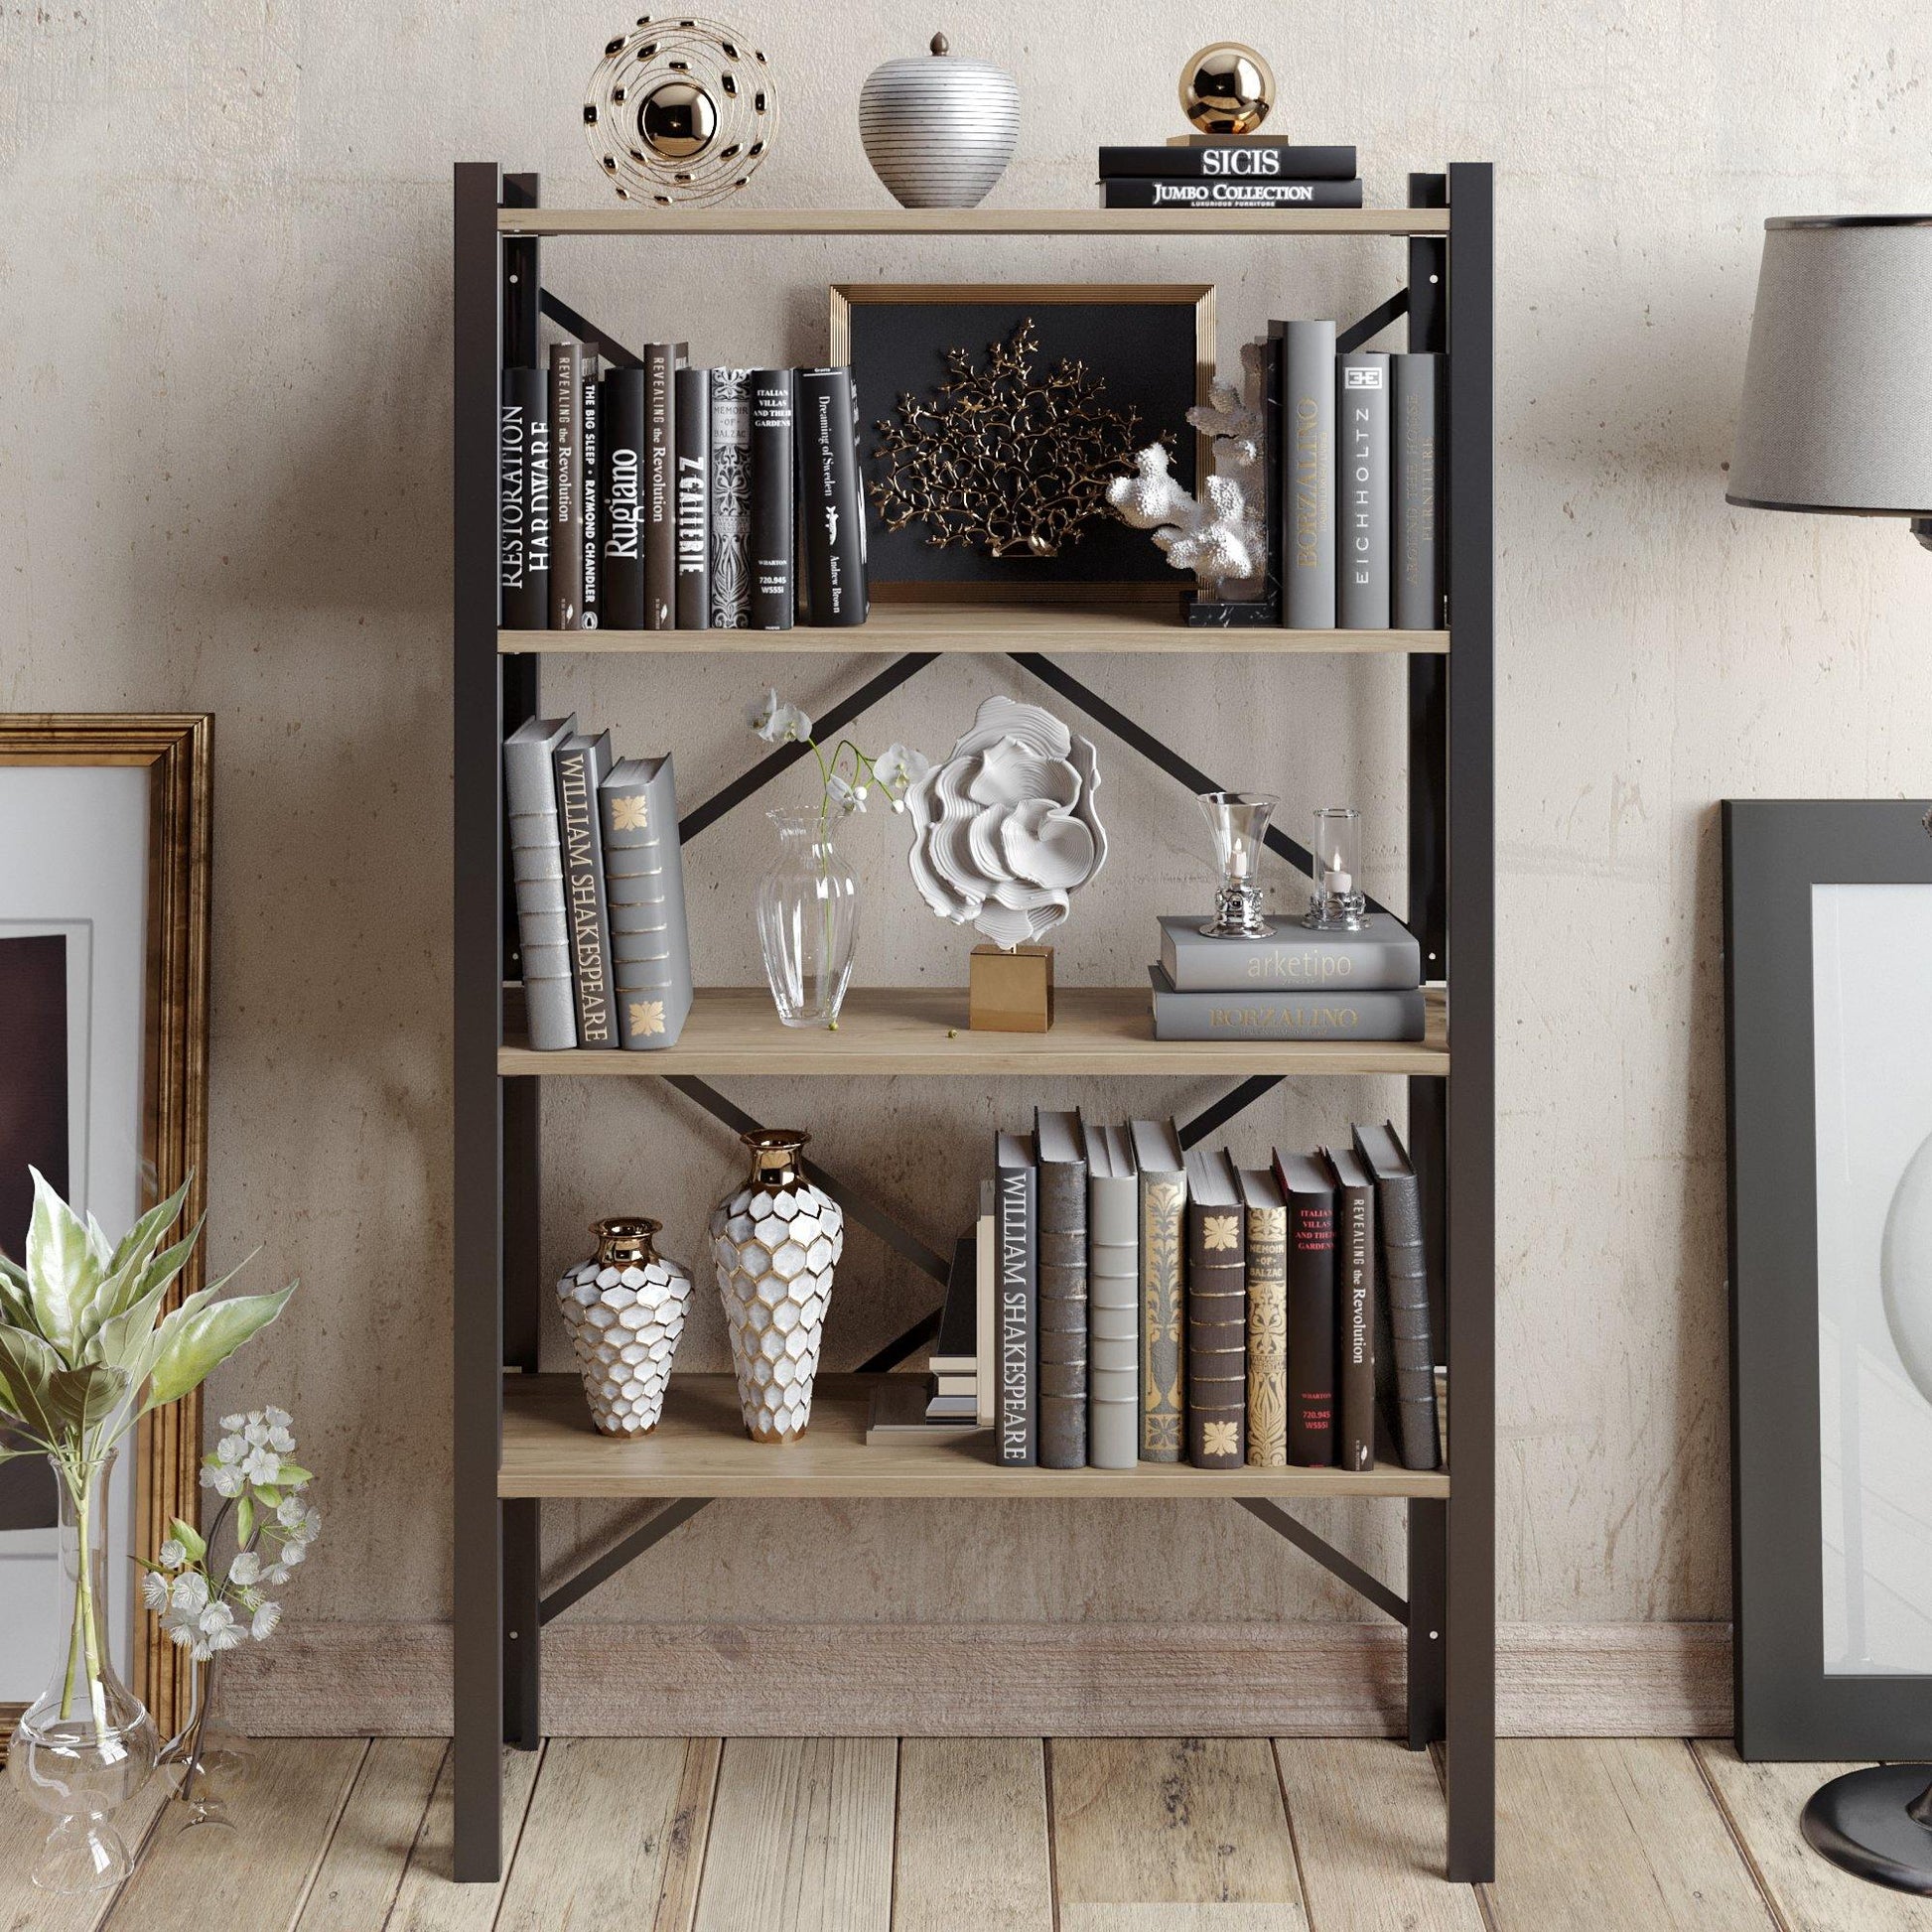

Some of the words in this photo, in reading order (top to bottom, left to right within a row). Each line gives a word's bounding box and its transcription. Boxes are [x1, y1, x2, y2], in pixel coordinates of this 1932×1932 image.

[1202, 149, 1280, 175] SICIS
[1153, 183, 1208, 204] JUMBO
[1212, 183, 1312, 201] COLLECTION
[558, 356, 570, 424] REVEALING
[585, 385, 596, 405] THE
[653, 356, 664, 424] REVEALING
[757, 388, 788, 397] ITALIAN
[585, 408, 596, 430] BIG
[714, 406, 748, 415] MEMOIR
[755, 419, 790, 428] GARDENS
[818, 396, 832, 445] Dreaming
[558, 427, 567, 444] the
[585, 433, 596, 467] SLEEP
[653, 427, 662, 444] the
[822, 447, 833, 458] of
[679, 456, 704, 472] Z
[823, 459, 834, 496] Sweden
[501, 405, 523, 589] RESTORATION
[528, 421, 549, 573] HARDWARE
[558, 447, 572, 523] Revolution
[653, 447, 666, 523] Revolution
[1296, 398, 1318, 570] BORZALINO
[1356, 408, 1369, 584] EICHHOLTZ
[585, 480, 596, 539] RAYMOND
[605, 448, 644, 560] Rugiano
[585, 542, 596, 603] CHANDLER
[830, 555, 841, 586] Andrew
[832, 588, 842, 615] Brown
[559, 753, 593, 868] WILLIAM
[571, 873, 608, 1041] SHAKESPEARE
[1247, 949, 1352, 983] arketipo
[1209, 1005, 1359, 1029] BORZALINO
[1003, 1173, 1027, 1285] WILLIAM
[1353, 1198, 1365, 1265] REVEALING
[1249, 1244, 1285, 1253] MEMOIR
[1249, 1268, 1283, 1277] BALZAC
[1353, 1270, 1362, 1285] the
[1353, 1289, 1366, 1364] Revolution
[1003, 1292, 1027, 1459] SHAKESPEARE
